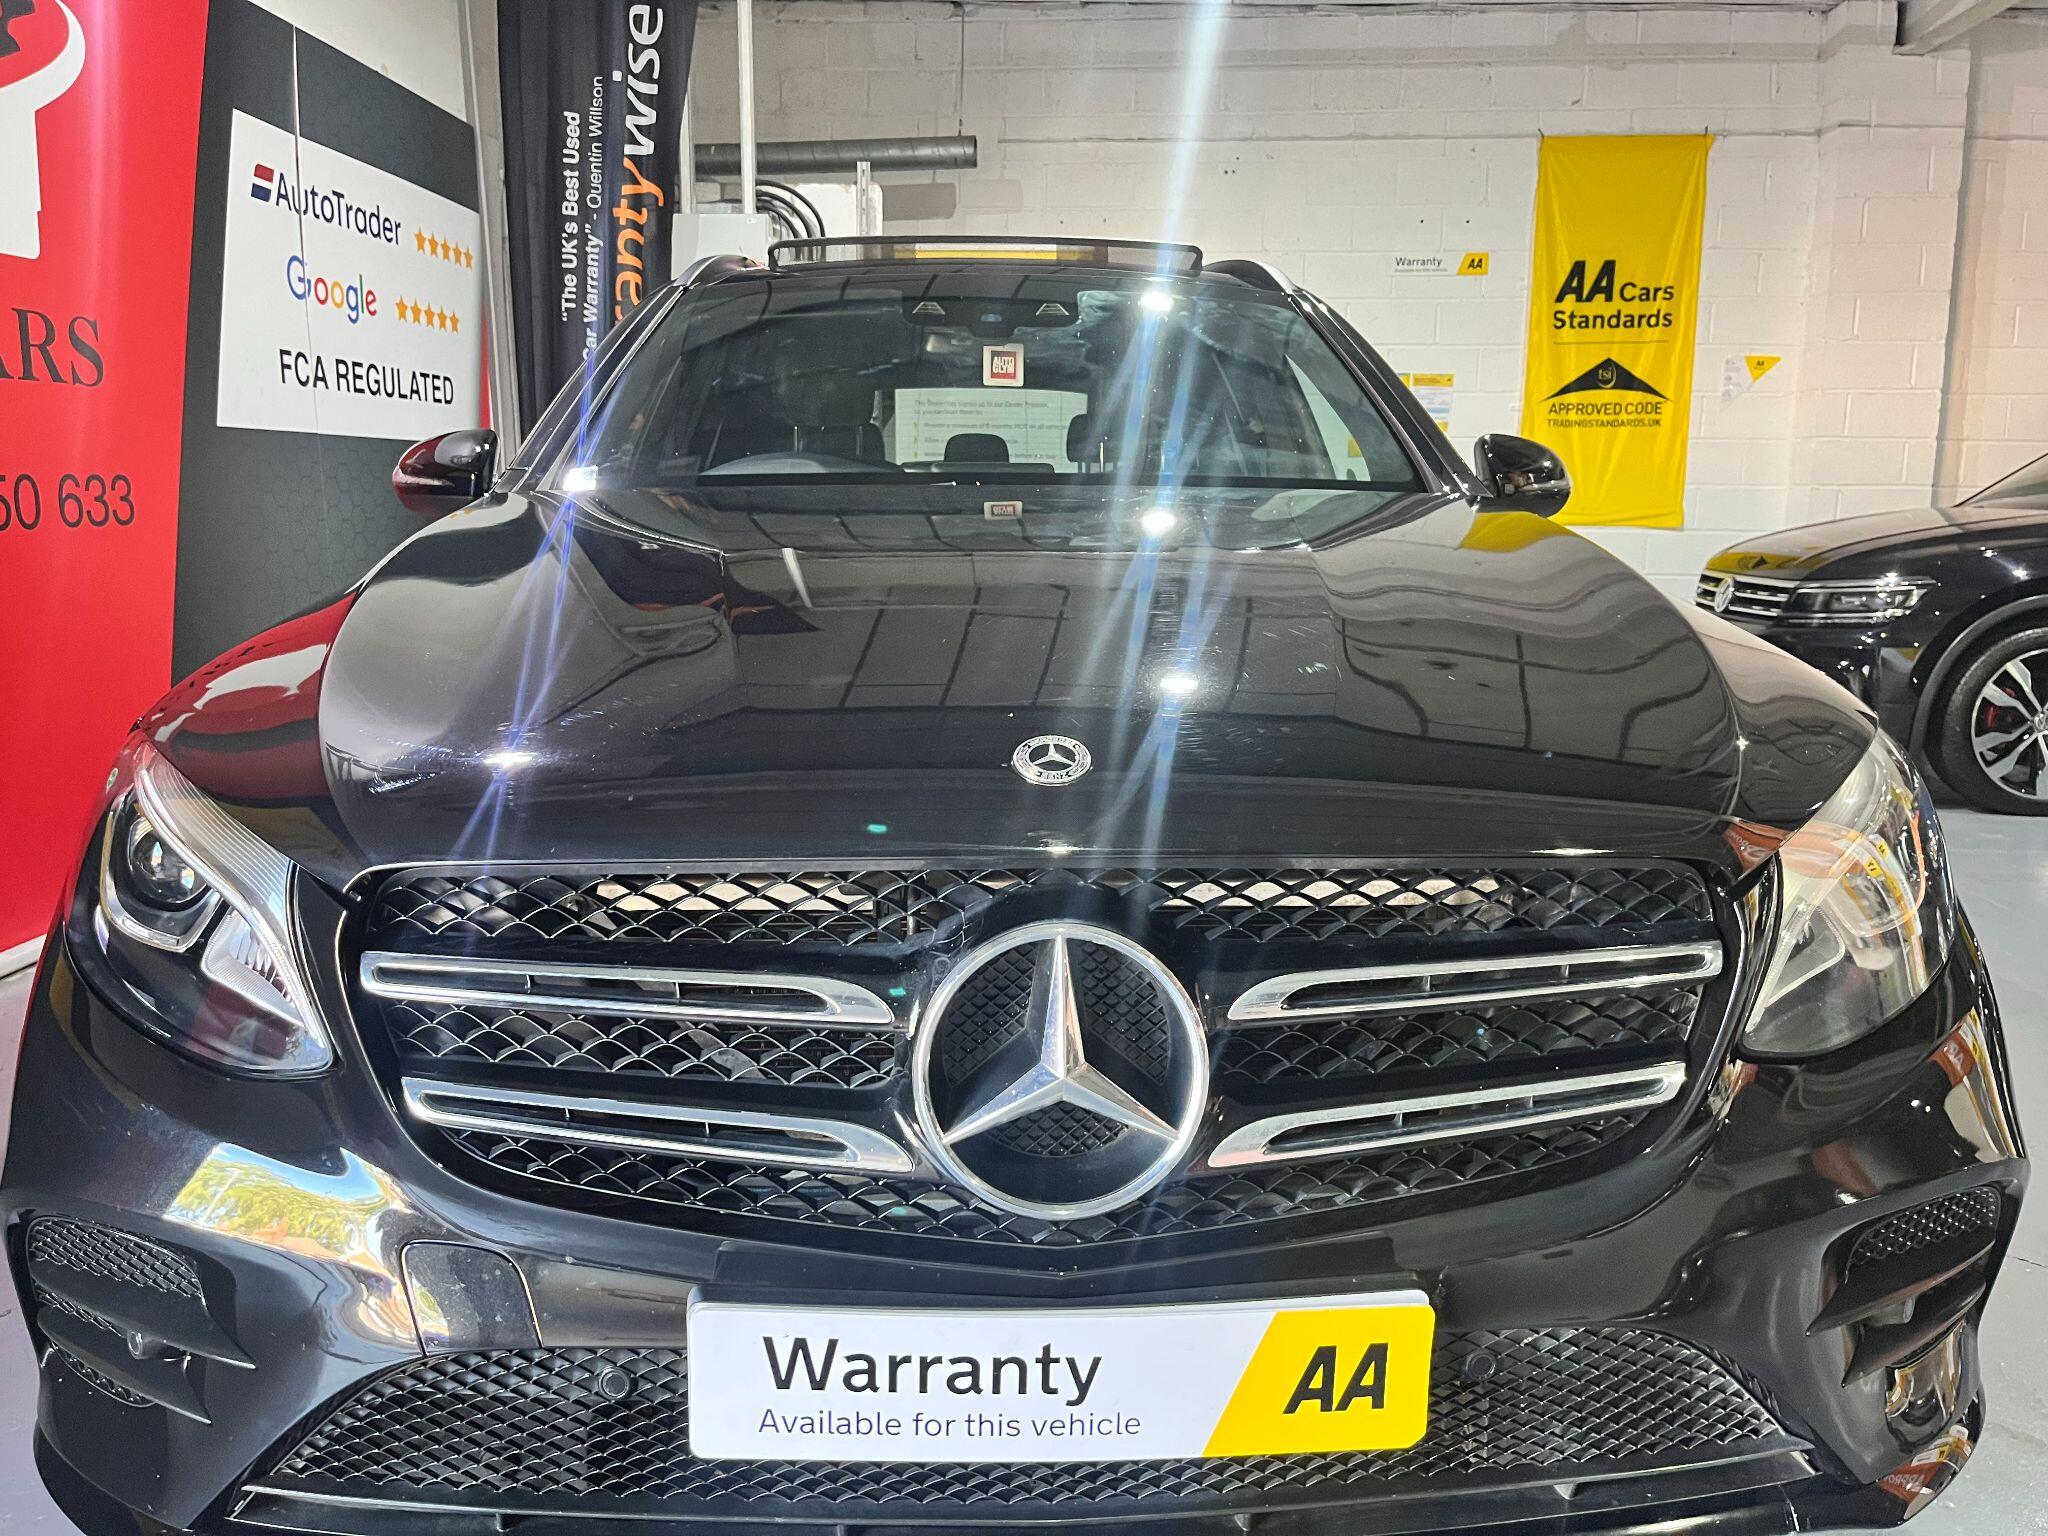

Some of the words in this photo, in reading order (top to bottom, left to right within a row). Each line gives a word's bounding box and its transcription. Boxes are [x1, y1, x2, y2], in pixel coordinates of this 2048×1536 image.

[588, 76, 604, 137] Willson
[563, 111, 581, 164] Used
[562, 169, 580, 216] Best
[586, 142, 603, 210] Quentin
[275, 171, 401, 245] AutoTrader
[286, 254, 377, 324] Google
[1395, 256, 1442, 267] Warranty
[1467, 258, 1483, 269] AA
[1554, 259, 1617, 303] AA
[1619, 281, 1675, 302] Cars
[0, 308, 104, 387] RS
[1553, 309, 1673, 330] Standards
[279, 348, 329, 390] FCA
[335, 358, 455, 405] REGULATED
[1547, 402, 1622, 415] APPROVED
[1624, 402, 1662, 415] CODE
[57, 473, 136, 529] 633
[762, 1335, 1103, 1407] Warranty
[1282, 1342, 1389, 1415] AA
[758, 1408, 902, 1437] Available
[912, 1412, 956, 1437] for
[964, 1412, 1021, 1438] this
[1031, 1411, 1142, 1437] vehicle
